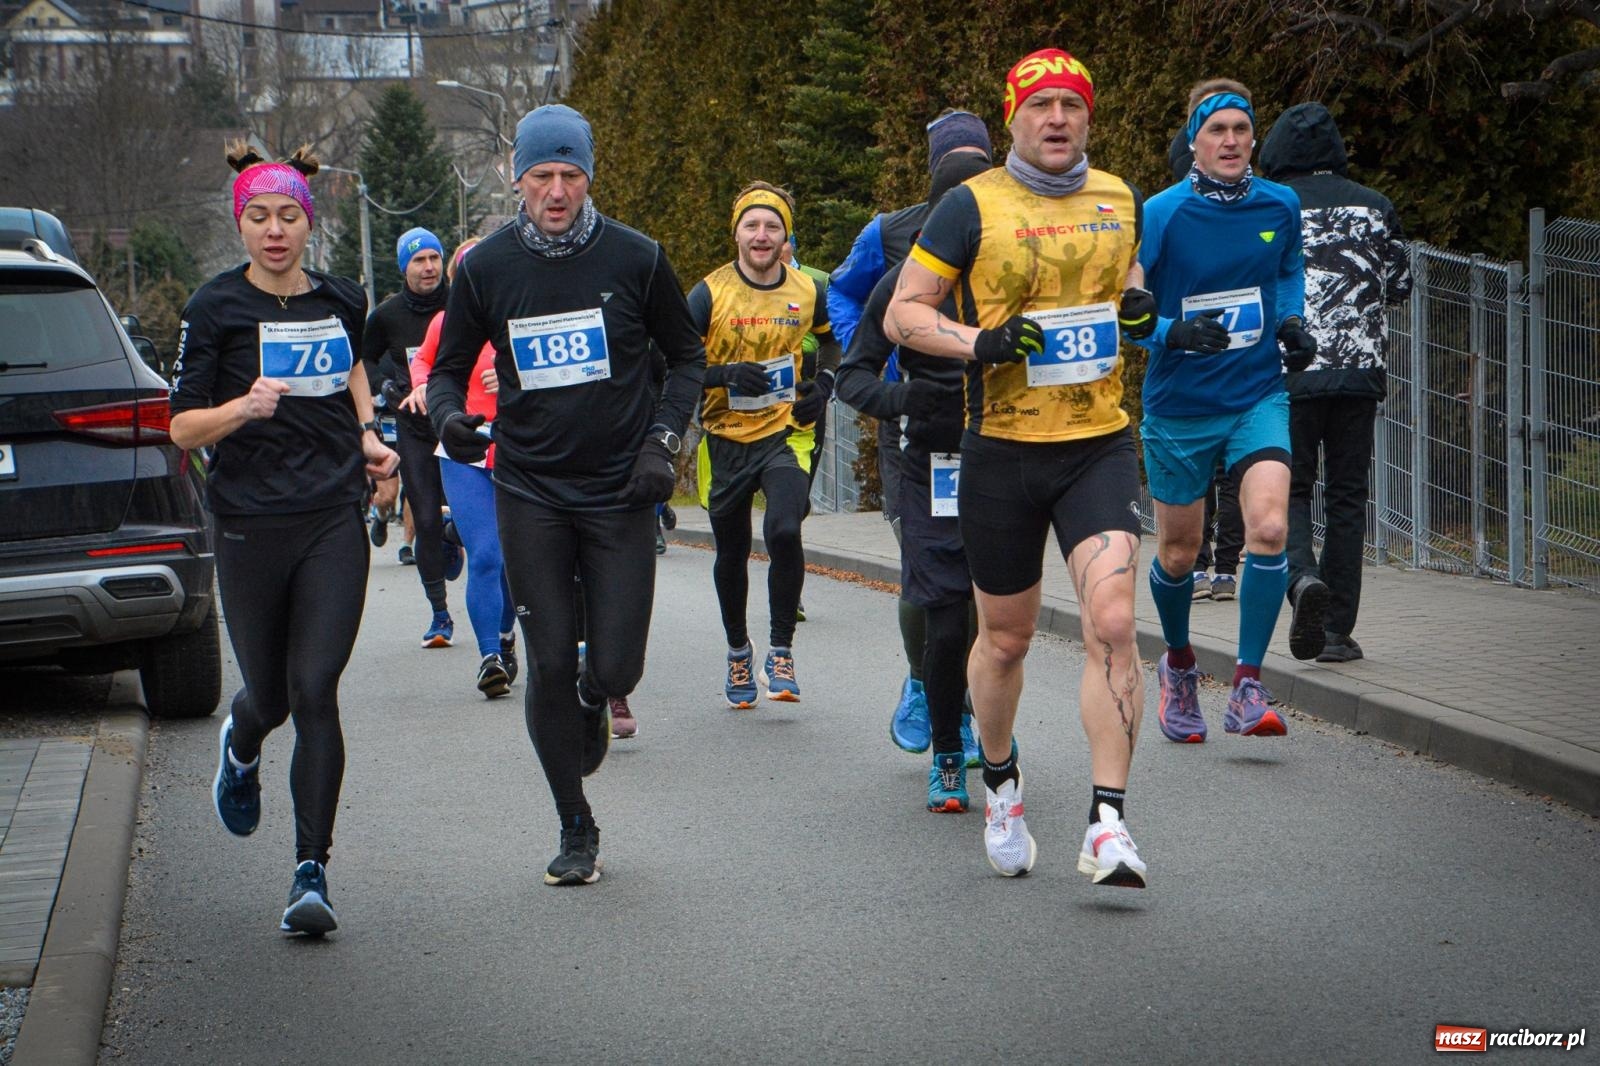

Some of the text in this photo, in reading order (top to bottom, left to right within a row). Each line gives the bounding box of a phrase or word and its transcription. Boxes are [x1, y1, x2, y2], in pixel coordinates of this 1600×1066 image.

[291, 341, 332, 375] 76
[528, 331, 591, 367] 188
[1056, 326, 1097, 360] 38
